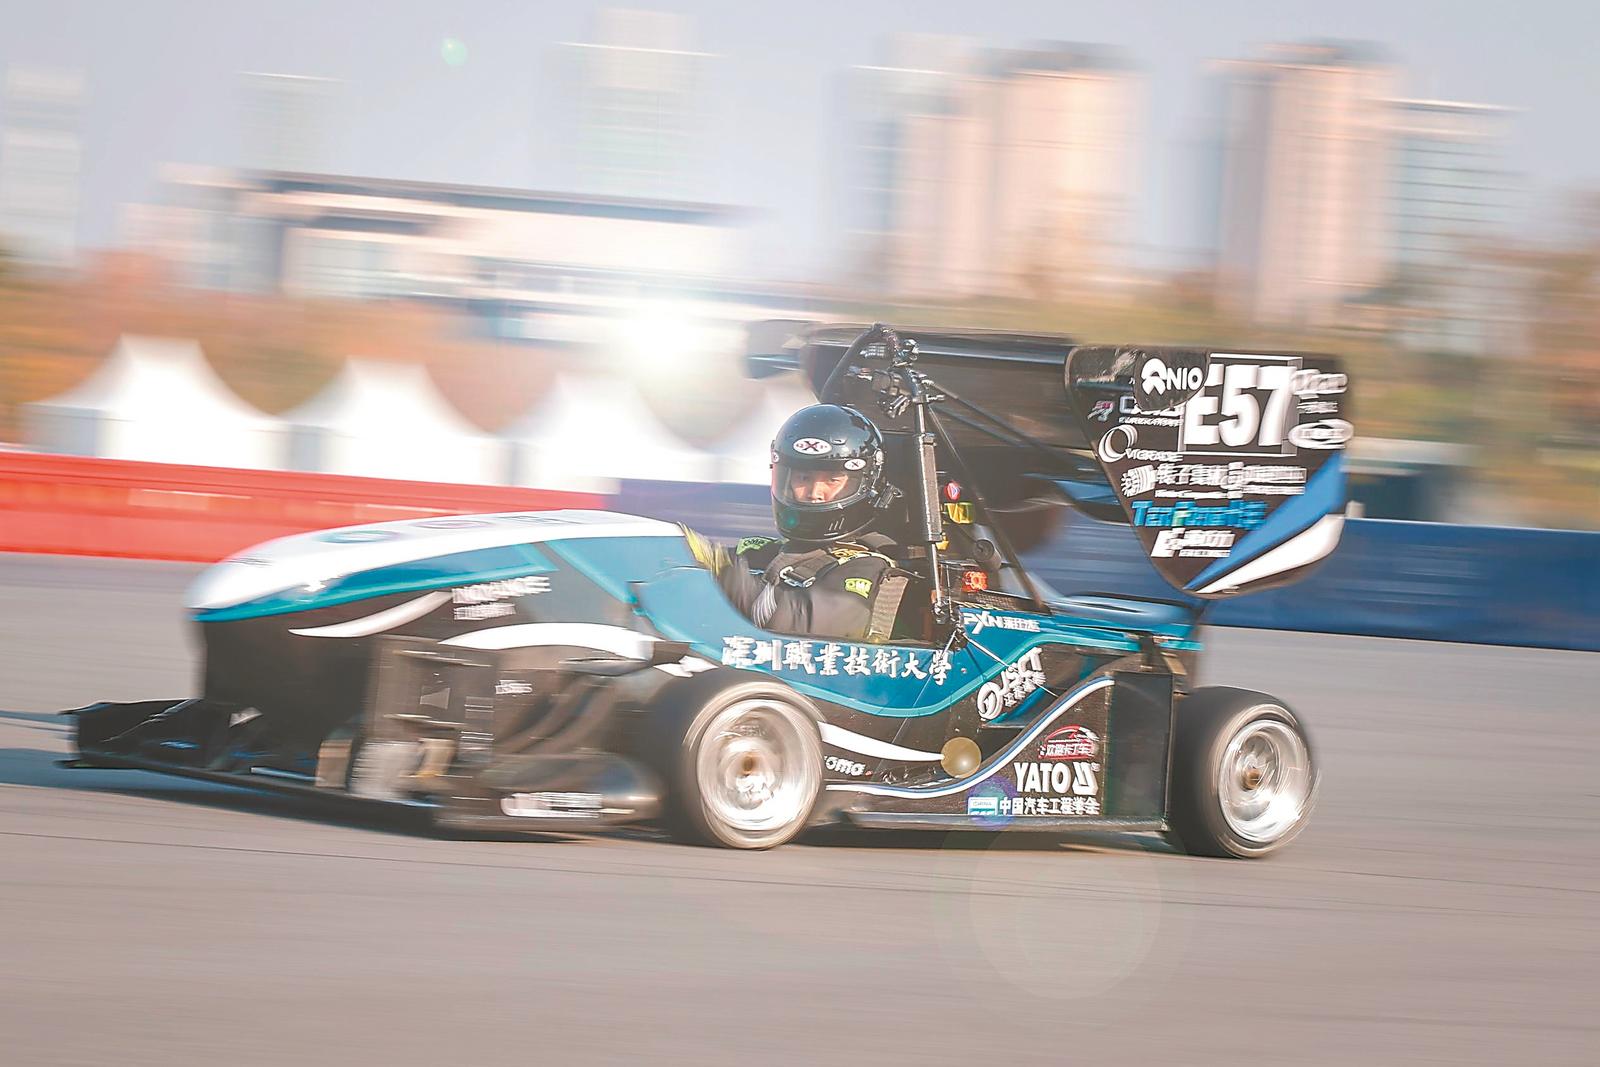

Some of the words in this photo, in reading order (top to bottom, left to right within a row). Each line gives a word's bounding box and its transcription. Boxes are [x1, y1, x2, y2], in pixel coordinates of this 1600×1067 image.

[1166, 367, 1203, 391] NIO
[1183, 363, 1298, 448] E57
[1013, 762, 1072, 794] YATO
[999, 796, 1101, 816] 中国汽车工程学会
